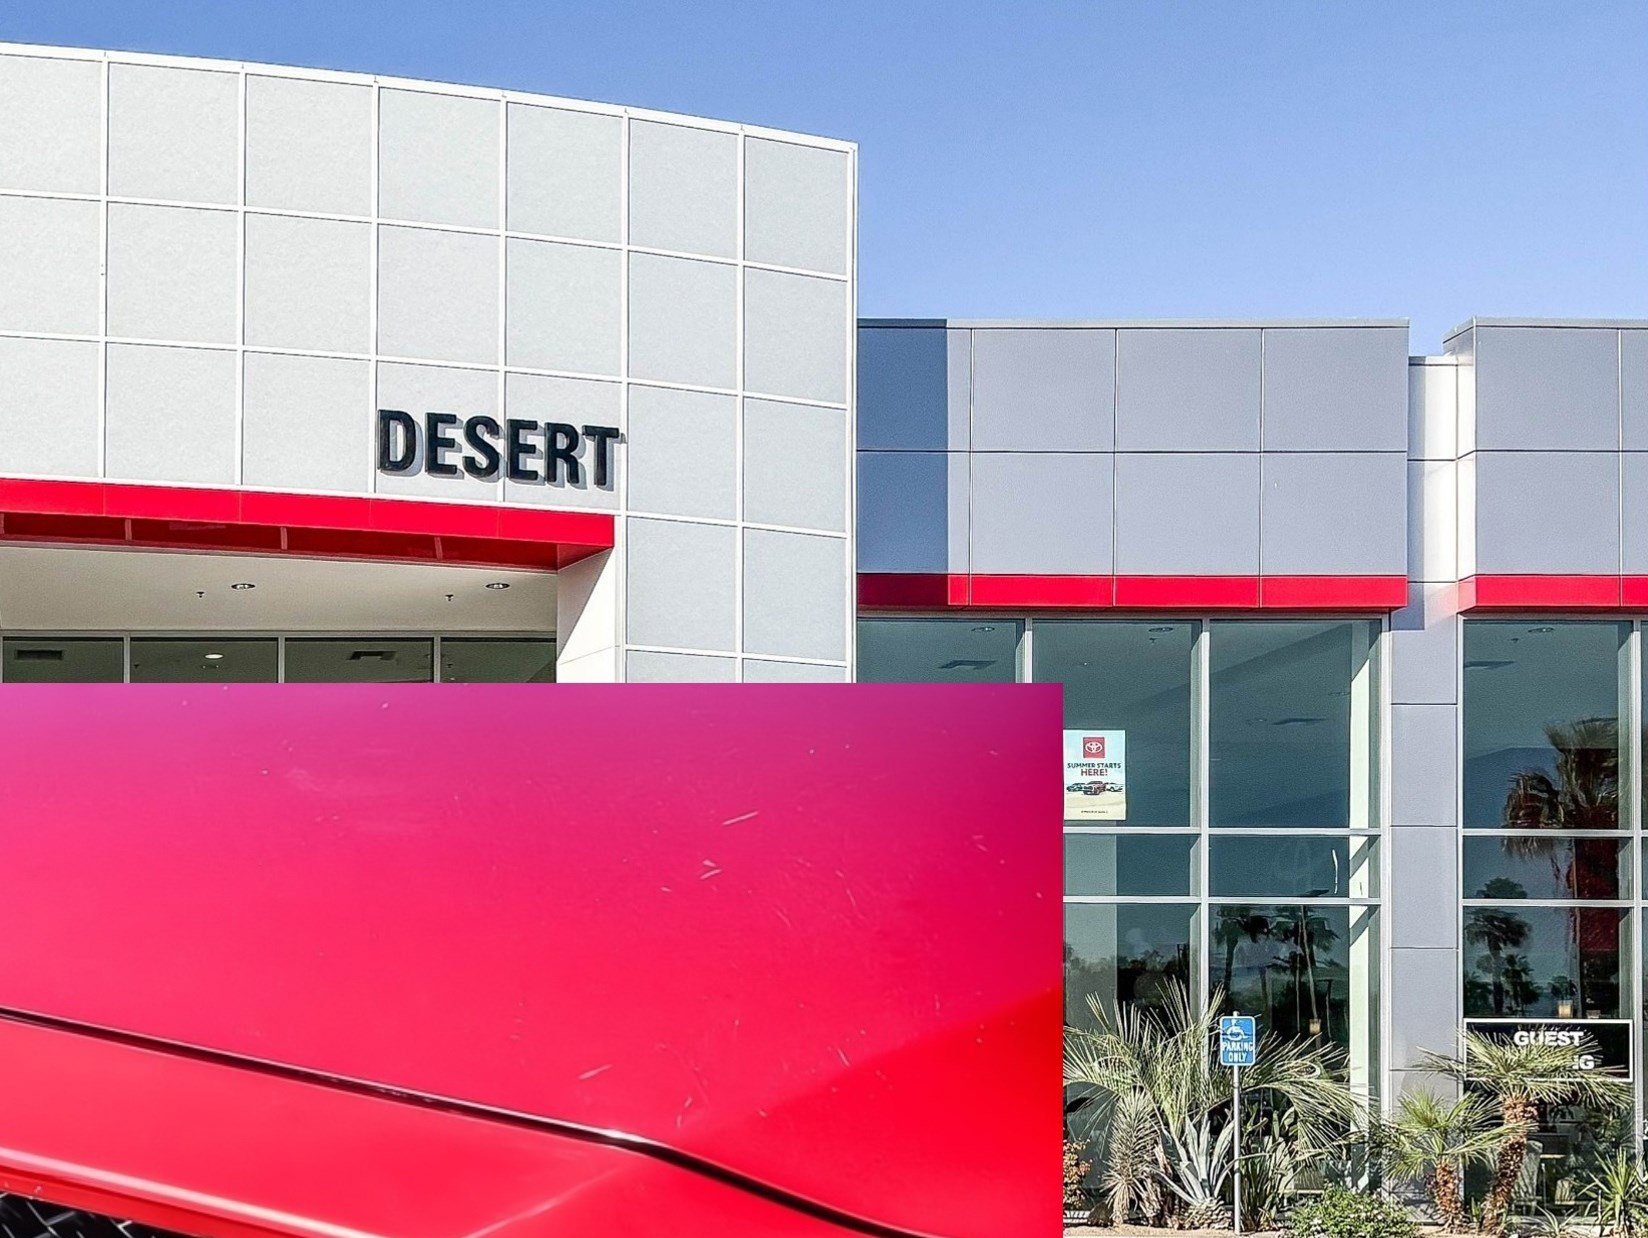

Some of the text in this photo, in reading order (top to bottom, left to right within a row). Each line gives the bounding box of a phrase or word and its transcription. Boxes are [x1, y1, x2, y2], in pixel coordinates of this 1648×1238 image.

[377, 409, 620, 487] DESERT
[1080, 768, 1108, 777] HERE!
[1513, 1030, 1585, 1047] GUEST
[1222, 1041, 1253, 1052] PARKING
[1228, 1051, 1247, 1063] ONLY
